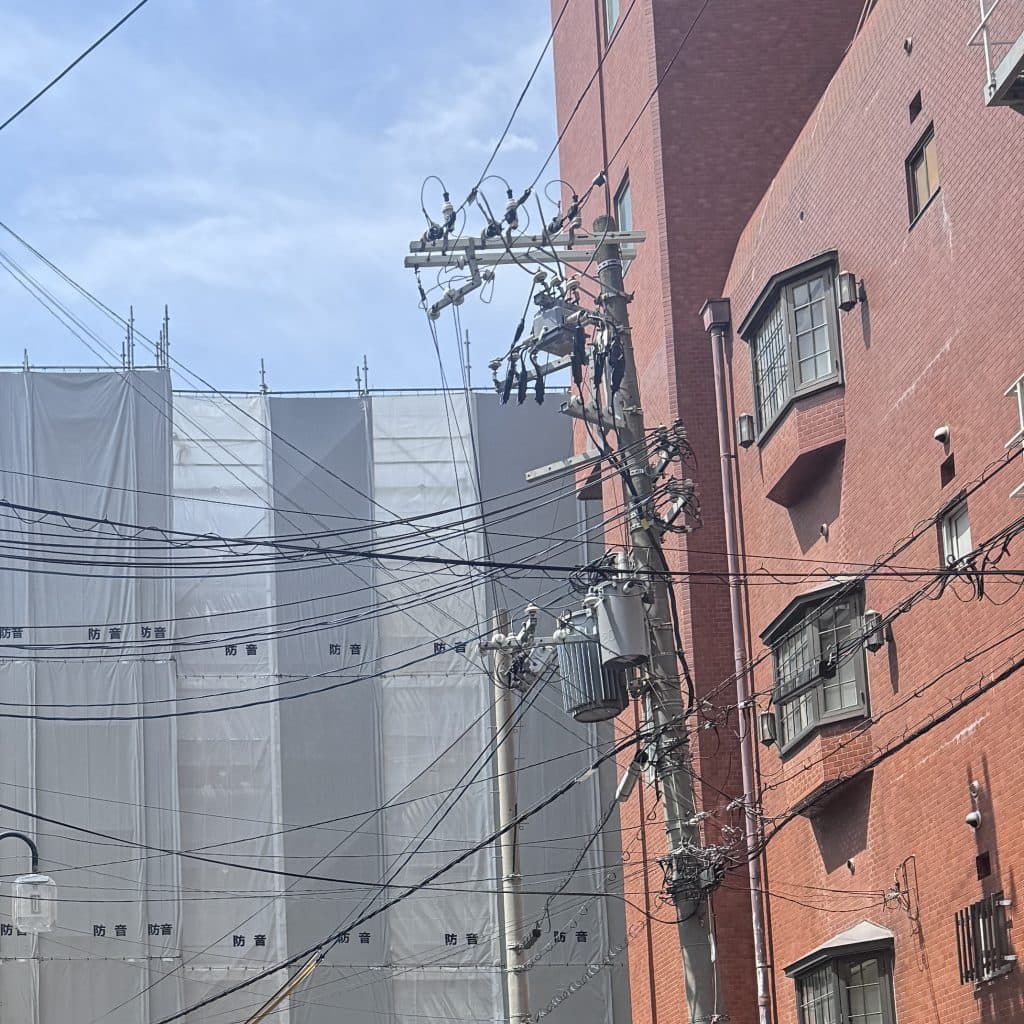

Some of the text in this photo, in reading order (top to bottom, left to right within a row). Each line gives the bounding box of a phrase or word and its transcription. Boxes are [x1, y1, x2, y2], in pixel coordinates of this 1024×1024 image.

[0, 626, 24, 639] 防音
[88, 627, 121, 640] 防音
[225, 644, 258, 656] 防音
[330, 643, 362, 656] 防音
[93, 924, 127, 937] 防音
[148, 923, 175, 936] 防音
[233, 934, 267, 947] 防音
[445, 933, 478, 945] 防音
